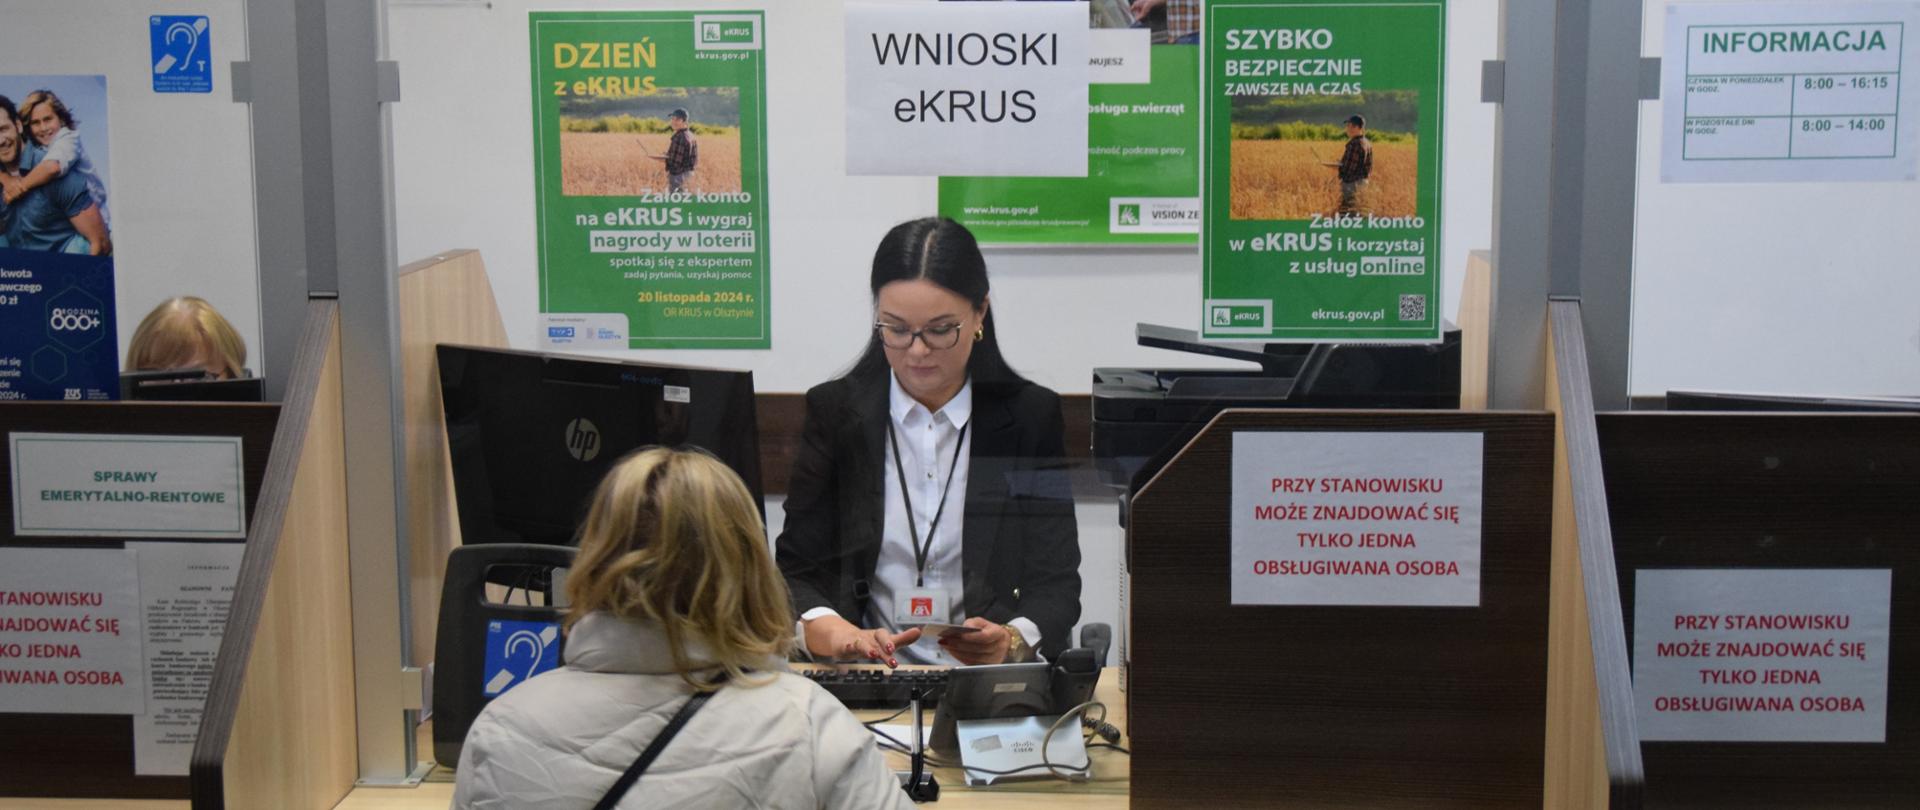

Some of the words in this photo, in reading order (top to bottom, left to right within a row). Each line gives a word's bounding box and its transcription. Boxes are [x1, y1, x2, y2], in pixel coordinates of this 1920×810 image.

[724, 28, 750, 36] eKRUS
[1225, 28, 1333, 51] SZYBKO
[872, 32, 1058, 66] WNIOSKI
[1703, 30, 1887, 53] INFORMACJA
[553, 36, 656, 69] DZIEŃ
[695, 51, 749, 61] ekrus.gov.pl
[1088, 57, 1124, 67] NUJESZ
[1225, 59, 1362, 77] BEZPIECZNIE
[554, 81, 567, 96] z
[573, 76, 657, 96] eKRUS
[1224, 83, 1289, 96] ZAWSZE
[1293, 83, 1315, 95] NA
[1320, 82, 1362, 95] CZAS
[1804, 78, 1834, 89] 8:00
[1851, 77, 1888, 89] 16:15
[894, 90, 1037, 123] eKRUS
[1132, 102, 1185, 116] zwierząt
[1802, 120, 1831, 131] 8:00
[1848, 119, 1885, 131] 14:00
[1123, 145, 1159, 156] podczas
[1161, 147, 1186, 156] pracy
[640, 187, 692, 203] Załóż
[697, 188, 751, 203] konto
[576, 214, 598, 226] na
[604, 207, 683, 226] eKRUS
[688, 212, 692, 226] i
[697, 213, 752, 229] wygraj
[964, 205, 1039, 216] www.krus.gov.pl
[1152, 210, 1185, 219] VISION
[1310, 213, 1363, 229] Załóż
[1368, 213, 1425, 229] konto
[594, 232, 673, 250] nagrody
[678, 236, 692, 247] w
[697, 232, 752, 247] loterii
[1229, 238, 1245, 251] w
[1251, 232, 1332, 251] eKRUS
[1338, 237, 1342, 251] i
[1346, 237, 1425, 255] korzystaj
[610, 256, 656, 270] spotkaj
[658, 256, 675, 269] się
[678, 259, 684, 267] z
[688, 256, 752, 269] ekspertem
[1290, 261, 1300, 273] z
[1305, 258, 1358, 277] usług
[1361, 258, 1424, 273] online
[624, 271, 648, 280] zadaj
[687, 271, 720, 280] uzyskaj
[721, 271, 752, 281] pomoc
[638, 292, 653, 302] 20
[655, 291, 711, 305] listopada
[713, 292, 743, 302] 2024
[745, 294, 754, 302] r.
[51, 309, 101, 330] 800+
[663, 308, 678, 317] OR
[678, 308, 702, 317] KRUS
[704, 309, 711, 317] w
[714, 308, 754, 320] Olsztynie
[1234, 312, 1260, 321] eKRUS
[1311, 308, 1384, 322] ekrus.gov.pl
[570, 418, 597, 460] hp
[94, 471, 158, 483] SPRAWY
[1271, 478, 1316, 493] PRZY
[1320, 477, 1444, 493] STANOWISKU
[40, 490, 226, 504] EMERYTALNO-RENTOWE
[1255, 503, 1308, 521] MOŻE
[1312, 502, 1428, 521] ZNAJDOWAĆ
[1433, 506, 1459, 524] SIĘ
[1296, 533, 1353, 549] TYLKO
[1358, 533, 1416, 549] JEDNA
[1253, 560, 1391, 576] OBSŁUGIWANA
[1395, 561, 1460, 576] OSOBA
[95, 619, 119, 636] SIĘ
[1675, 615, 1719, 630] PRZY
[1725, 615, 1849, 630] STANOWISKU
[27, 644, 81, 659] JEDNA
[1657, 641, 1710, 657] MOŻE
[1716, 640, 1834, 657] ZNAJDOWAĆ
[1839, 642, 1866, 661] SIĘ
[64, 670, 124, 686] OSOBA
[1700, 670, 1756, 685] TYLKO
[1761, 670, 1821, 685] JEDNA
[1655, 697, 1794, 712] OBSŁUGIWANA
[1800, 697, 1865, 712] OSOBA
